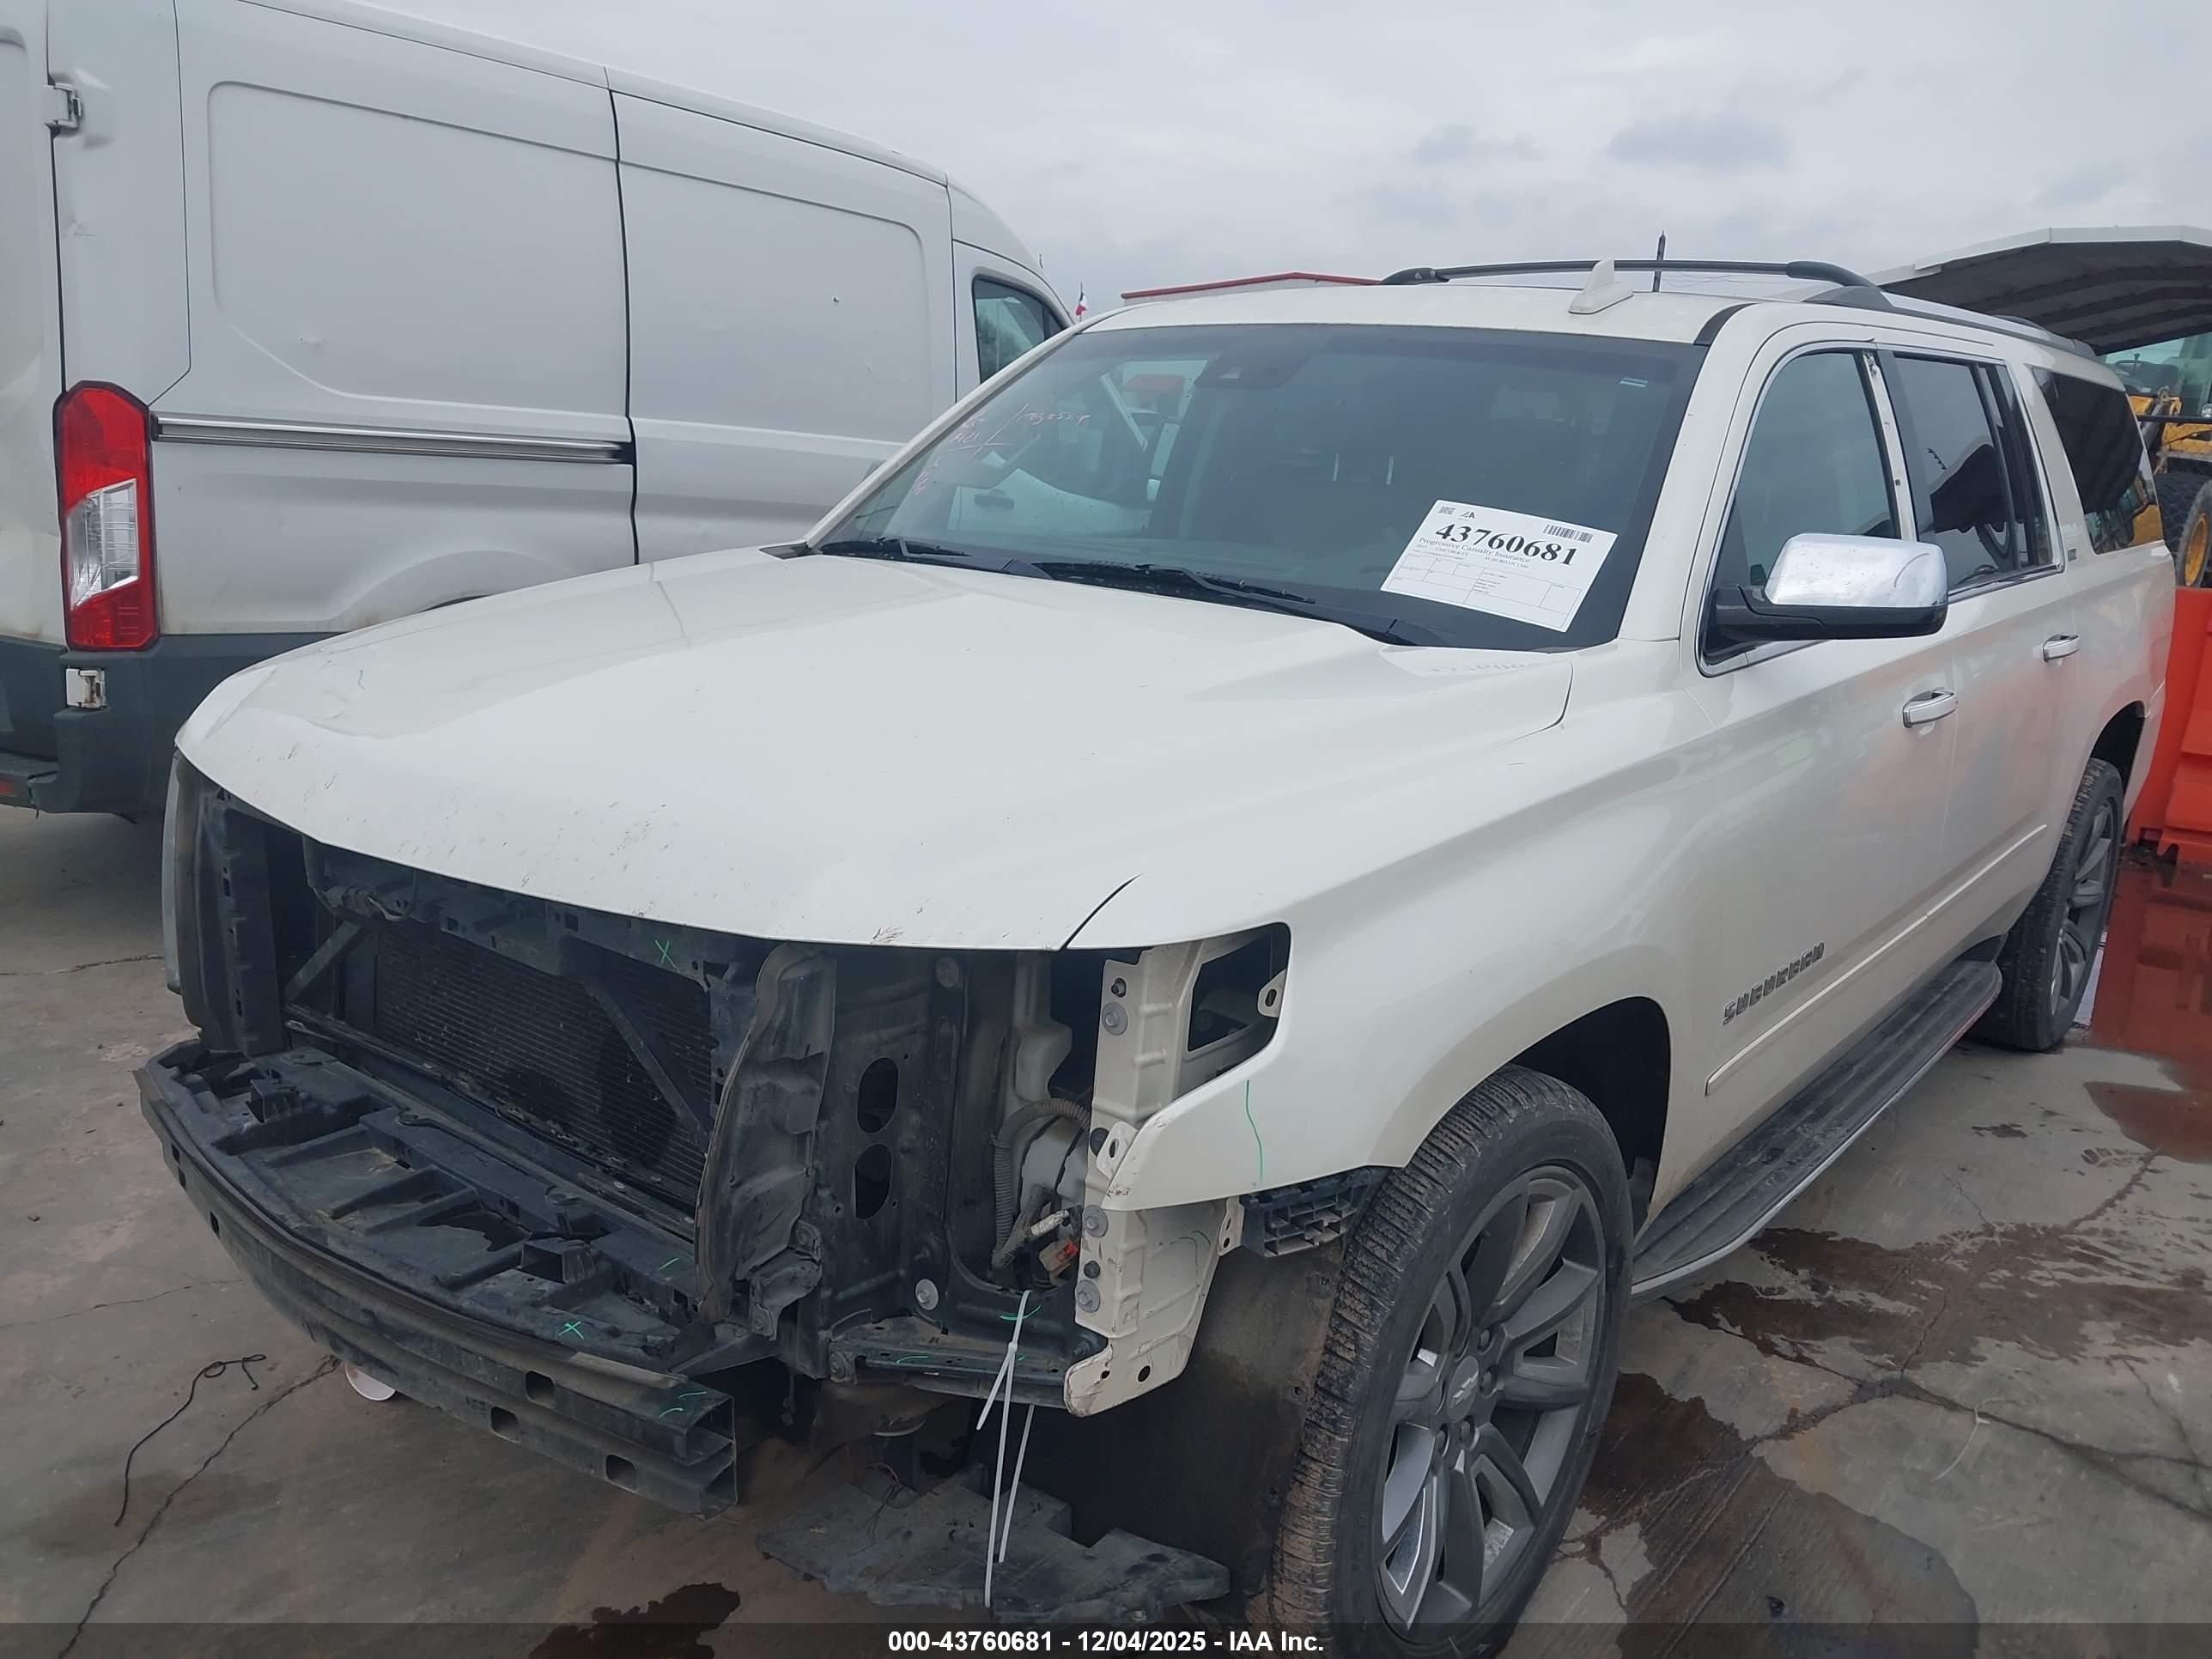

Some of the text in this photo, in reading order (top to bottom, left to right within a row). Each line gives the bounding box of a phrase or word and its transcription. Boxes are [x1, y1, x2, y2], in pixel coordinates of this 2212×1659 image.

[1419, 537, 1461, 550] Progressive
[1462, 544, 1492, 556] Casualty
[1494, 551, 1531, 563] Insurance
[1436, 523, 1577, 566] 43760681
[1723, 941, 1826, 1025] SUBURBAN
